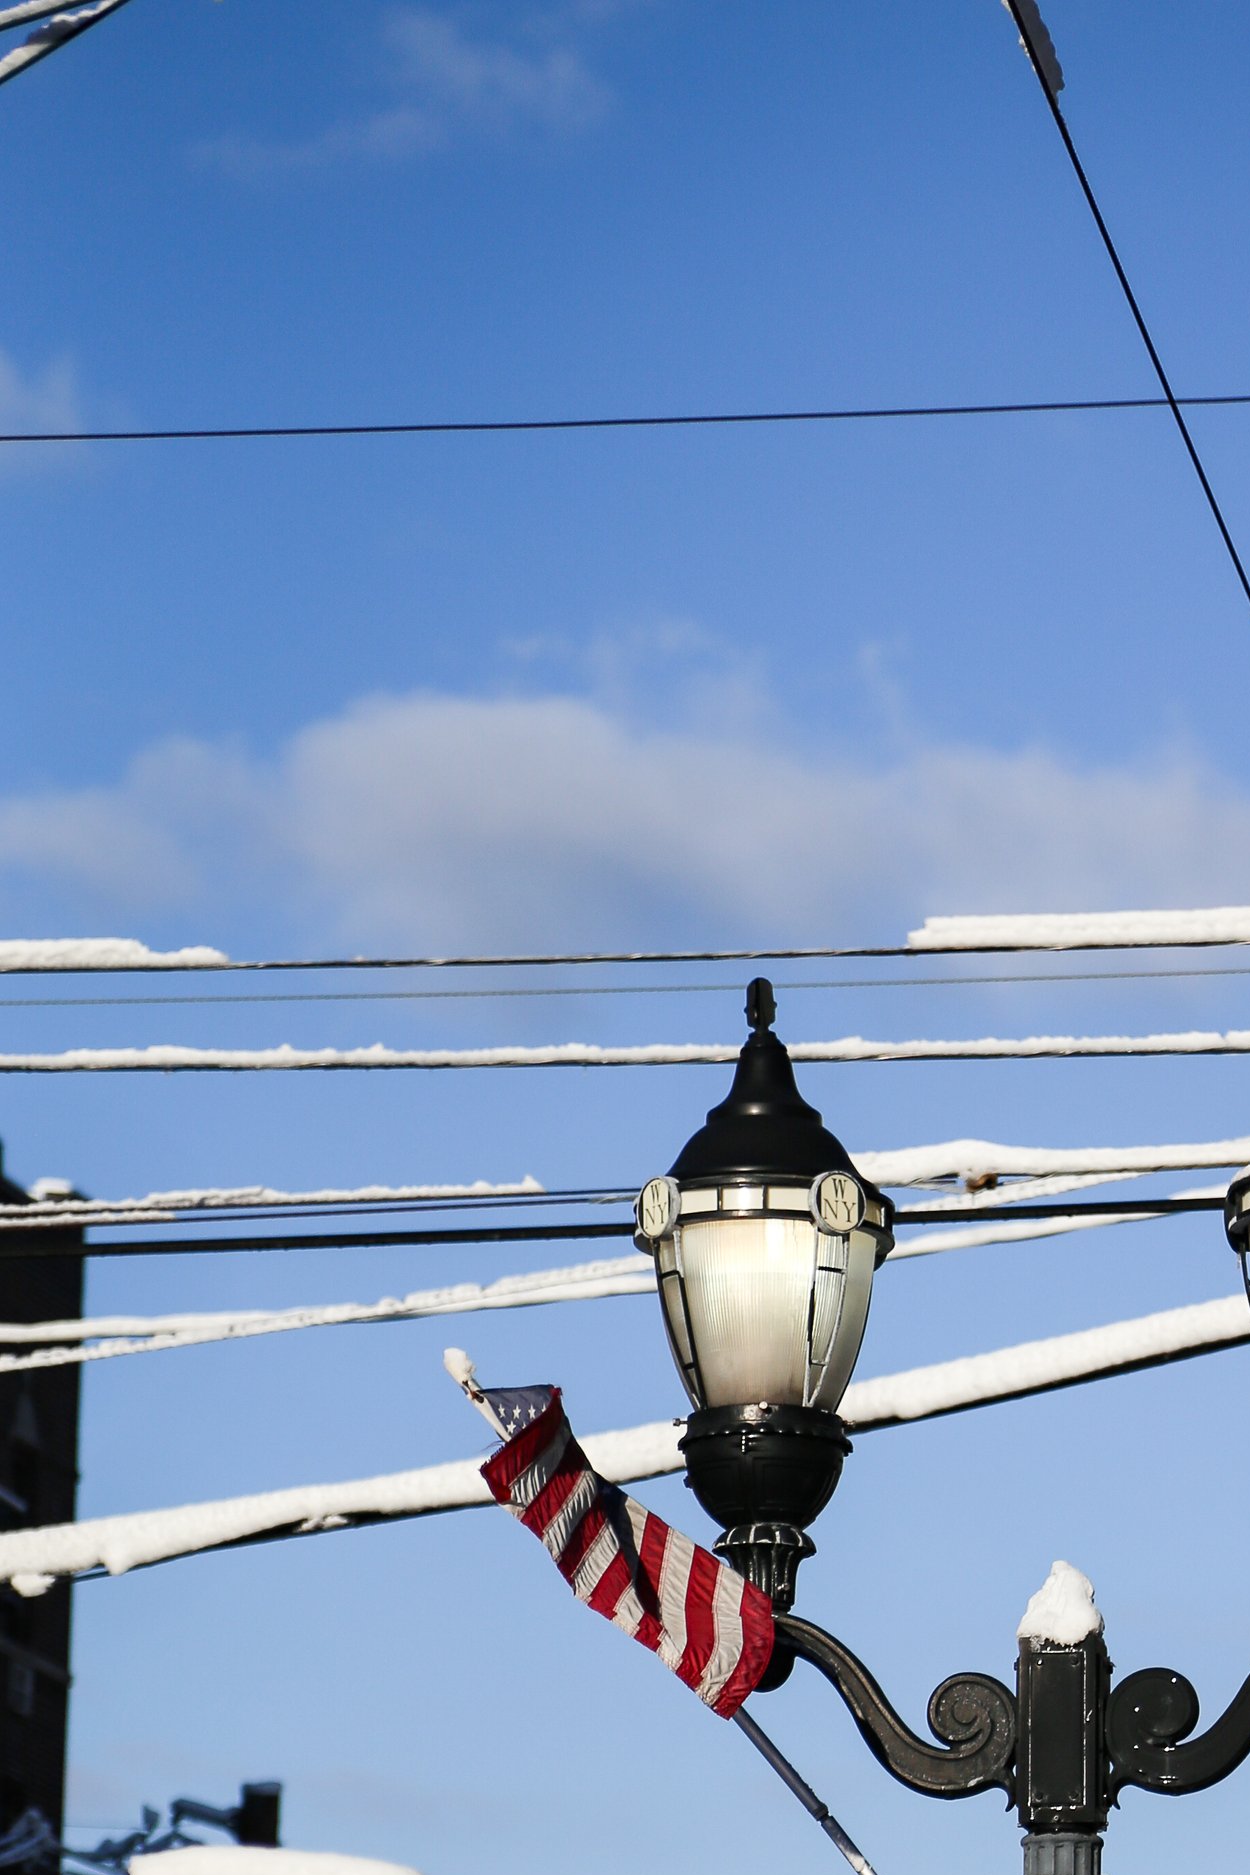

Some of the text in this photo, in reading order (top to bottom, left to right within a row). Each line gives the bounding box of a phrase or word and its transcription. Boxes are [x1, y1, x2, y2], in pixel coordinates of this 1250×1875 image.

[649, 1184, 662, 1203] W
[831, 1178, 848, 1200] W
[645, 1202, 667, 1229] NY
[823, 1198, 857, 1223] NY
